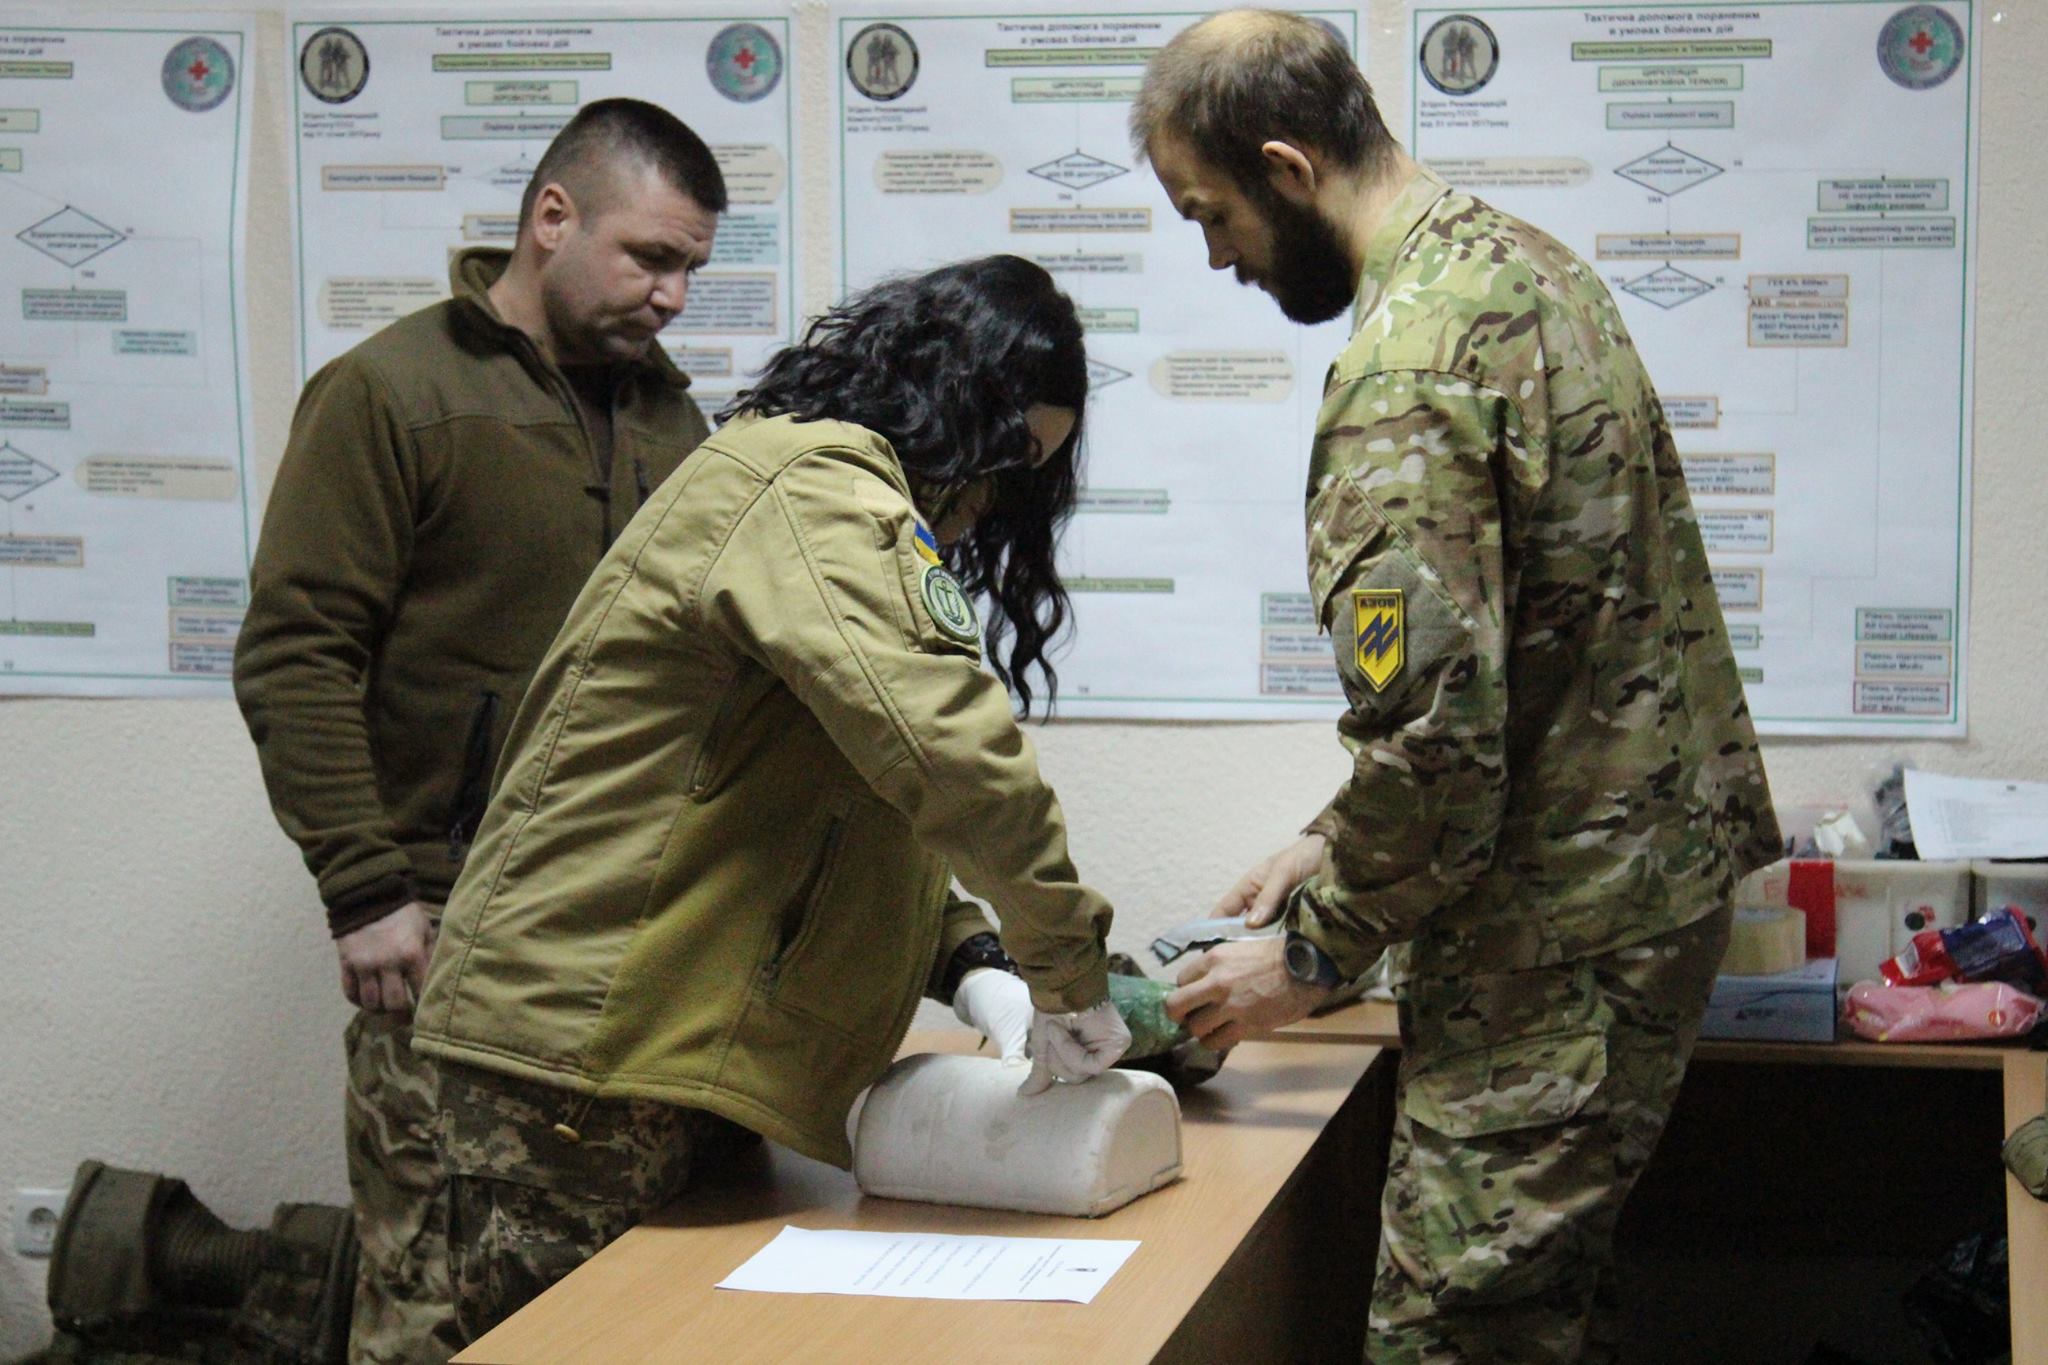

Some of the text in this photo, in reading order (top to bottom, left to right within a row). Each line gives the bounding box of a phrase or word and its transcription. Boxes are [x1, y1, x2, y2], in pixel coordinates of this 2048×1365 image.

[1584, 12, 1760, 22] Тактична допомога пораненим
[998, 23, 1044, 32] Тактична
[1047, 22, 1098, 32] допомога
[1619, 26, 1660, 36] умовах
[1664, 24, 1713, 34] бойових
[1716, 24, 1734, 35] дій
[1031, 36, 1068, 45] умовах
[1120, 34, 1136, 44] дій
